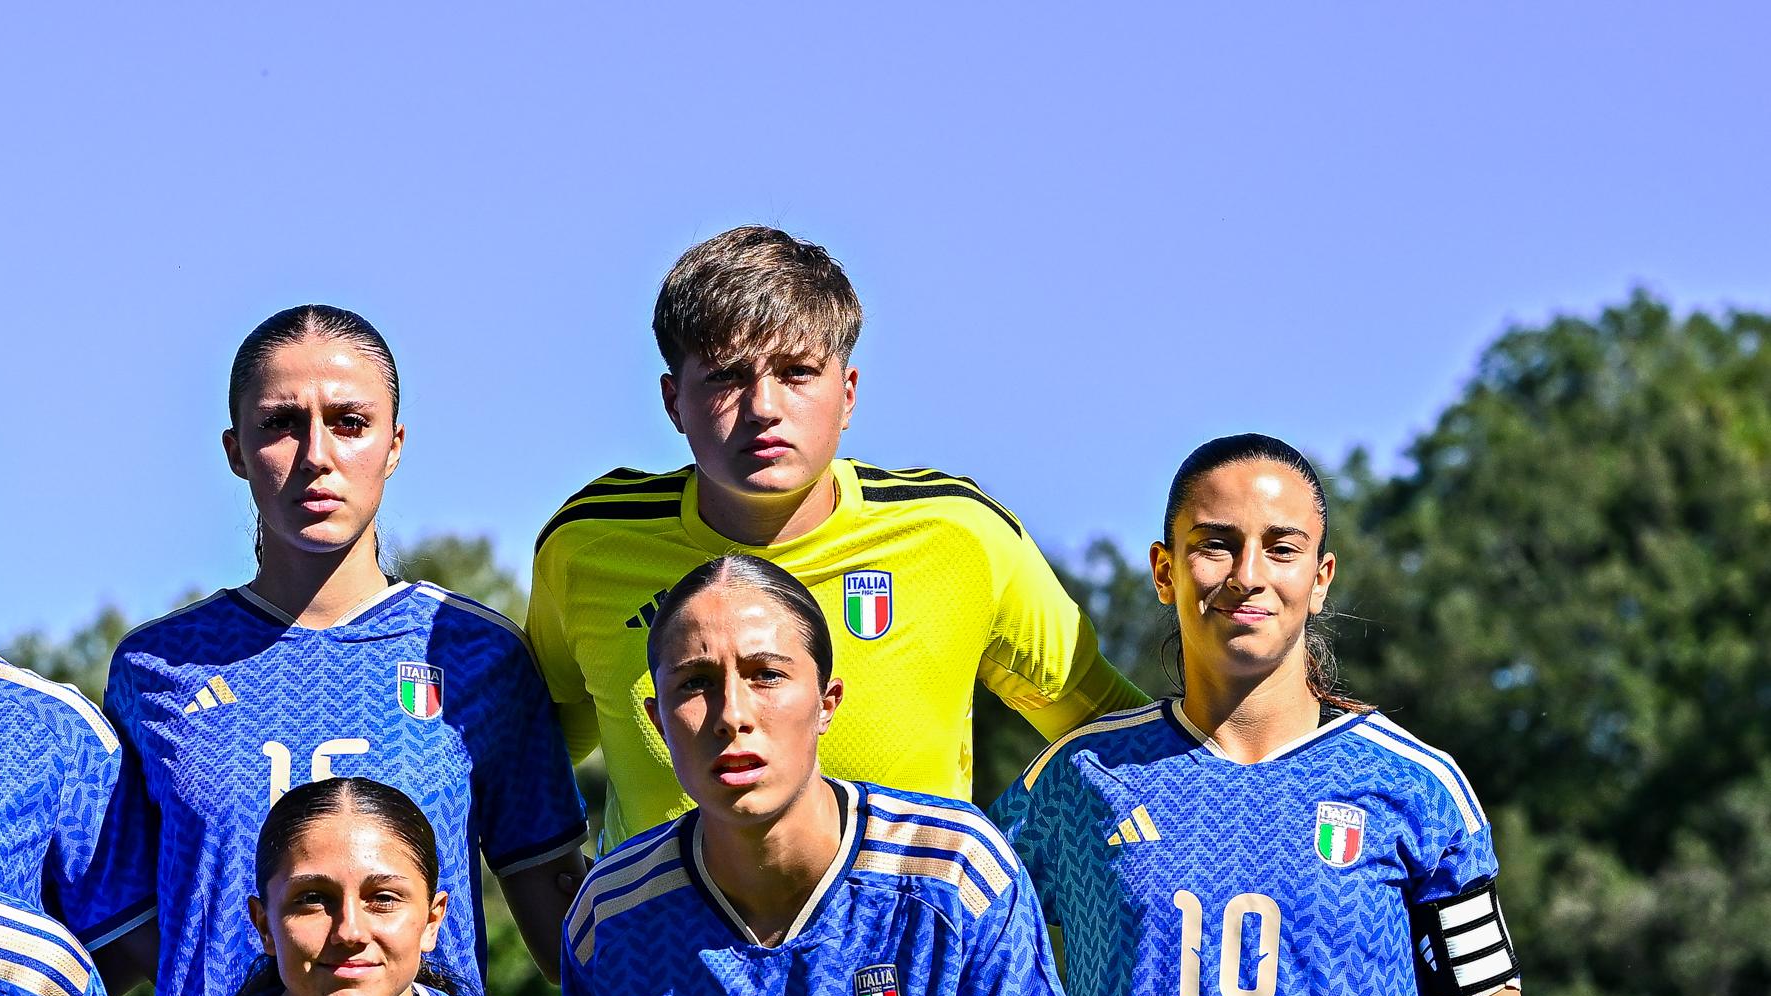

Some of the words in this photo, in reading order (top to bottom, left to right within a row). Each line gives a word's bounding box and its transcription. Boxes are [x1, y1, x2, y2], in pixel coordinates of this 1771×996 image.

[847, 576, 888, 589] ITALIA
[401, 666, 439, 681] ITALIA
[858, 970, 895, 989] ITALIA
